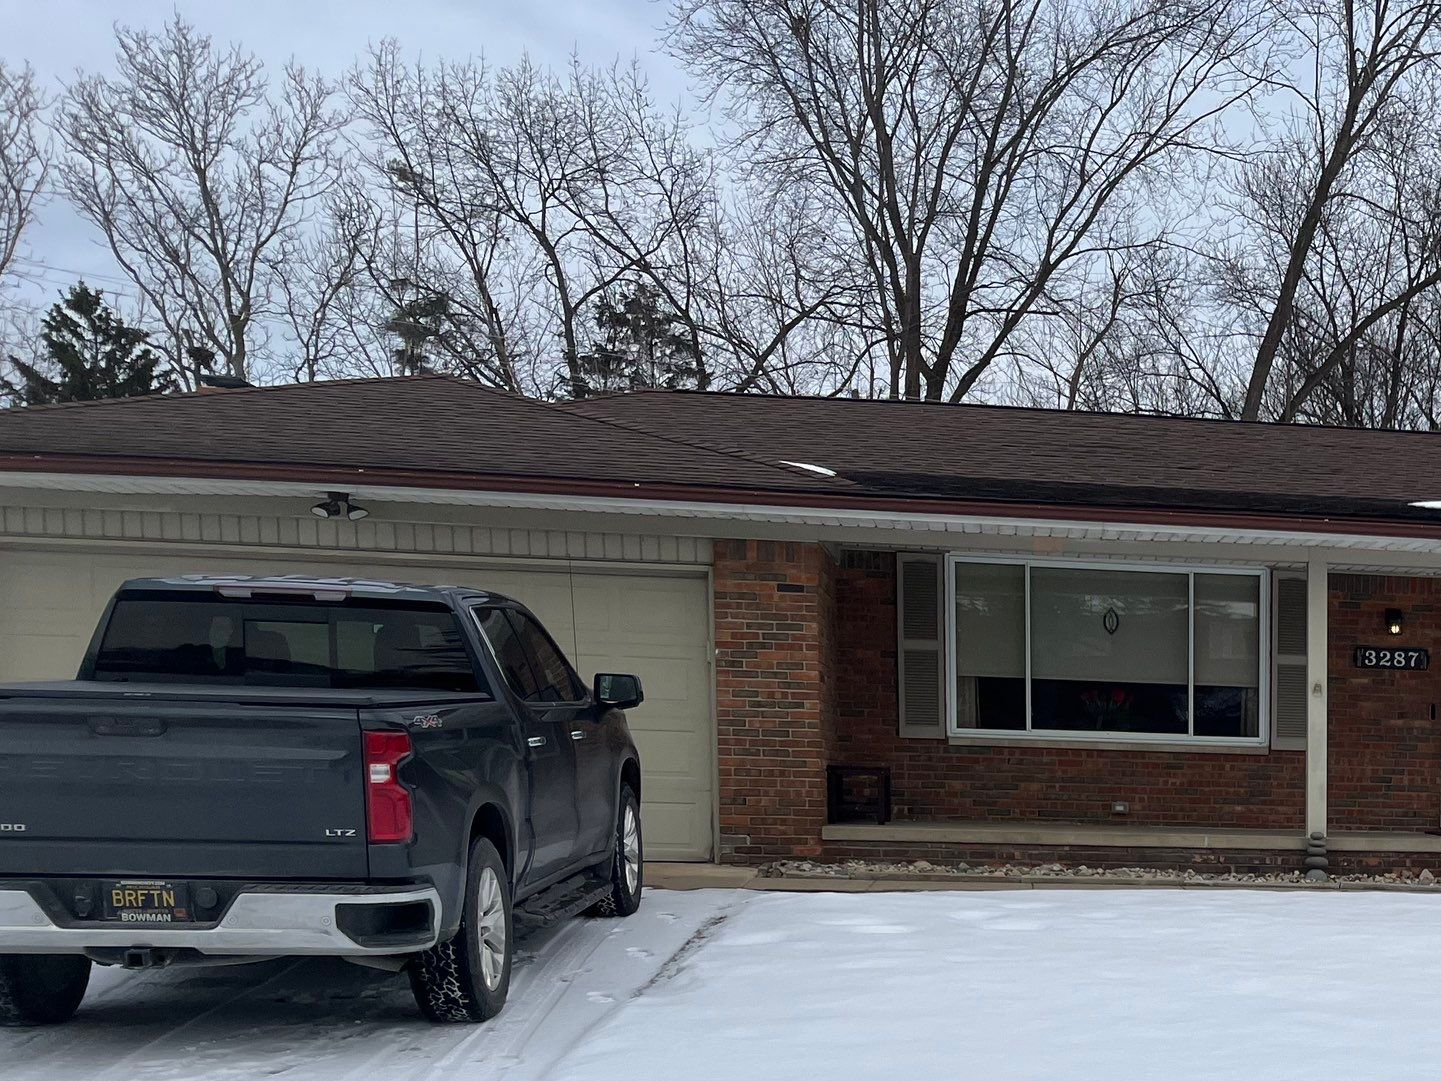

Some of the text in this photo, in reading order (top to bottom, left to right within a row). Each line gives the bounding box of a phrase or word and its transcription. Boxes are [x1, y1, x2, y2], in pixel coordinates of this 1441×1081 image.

[1365, 650, 1419, 667] 3287
[112, 889, 175, 907] BRFTN
[121, 913, 171, 922] BOWMAN
